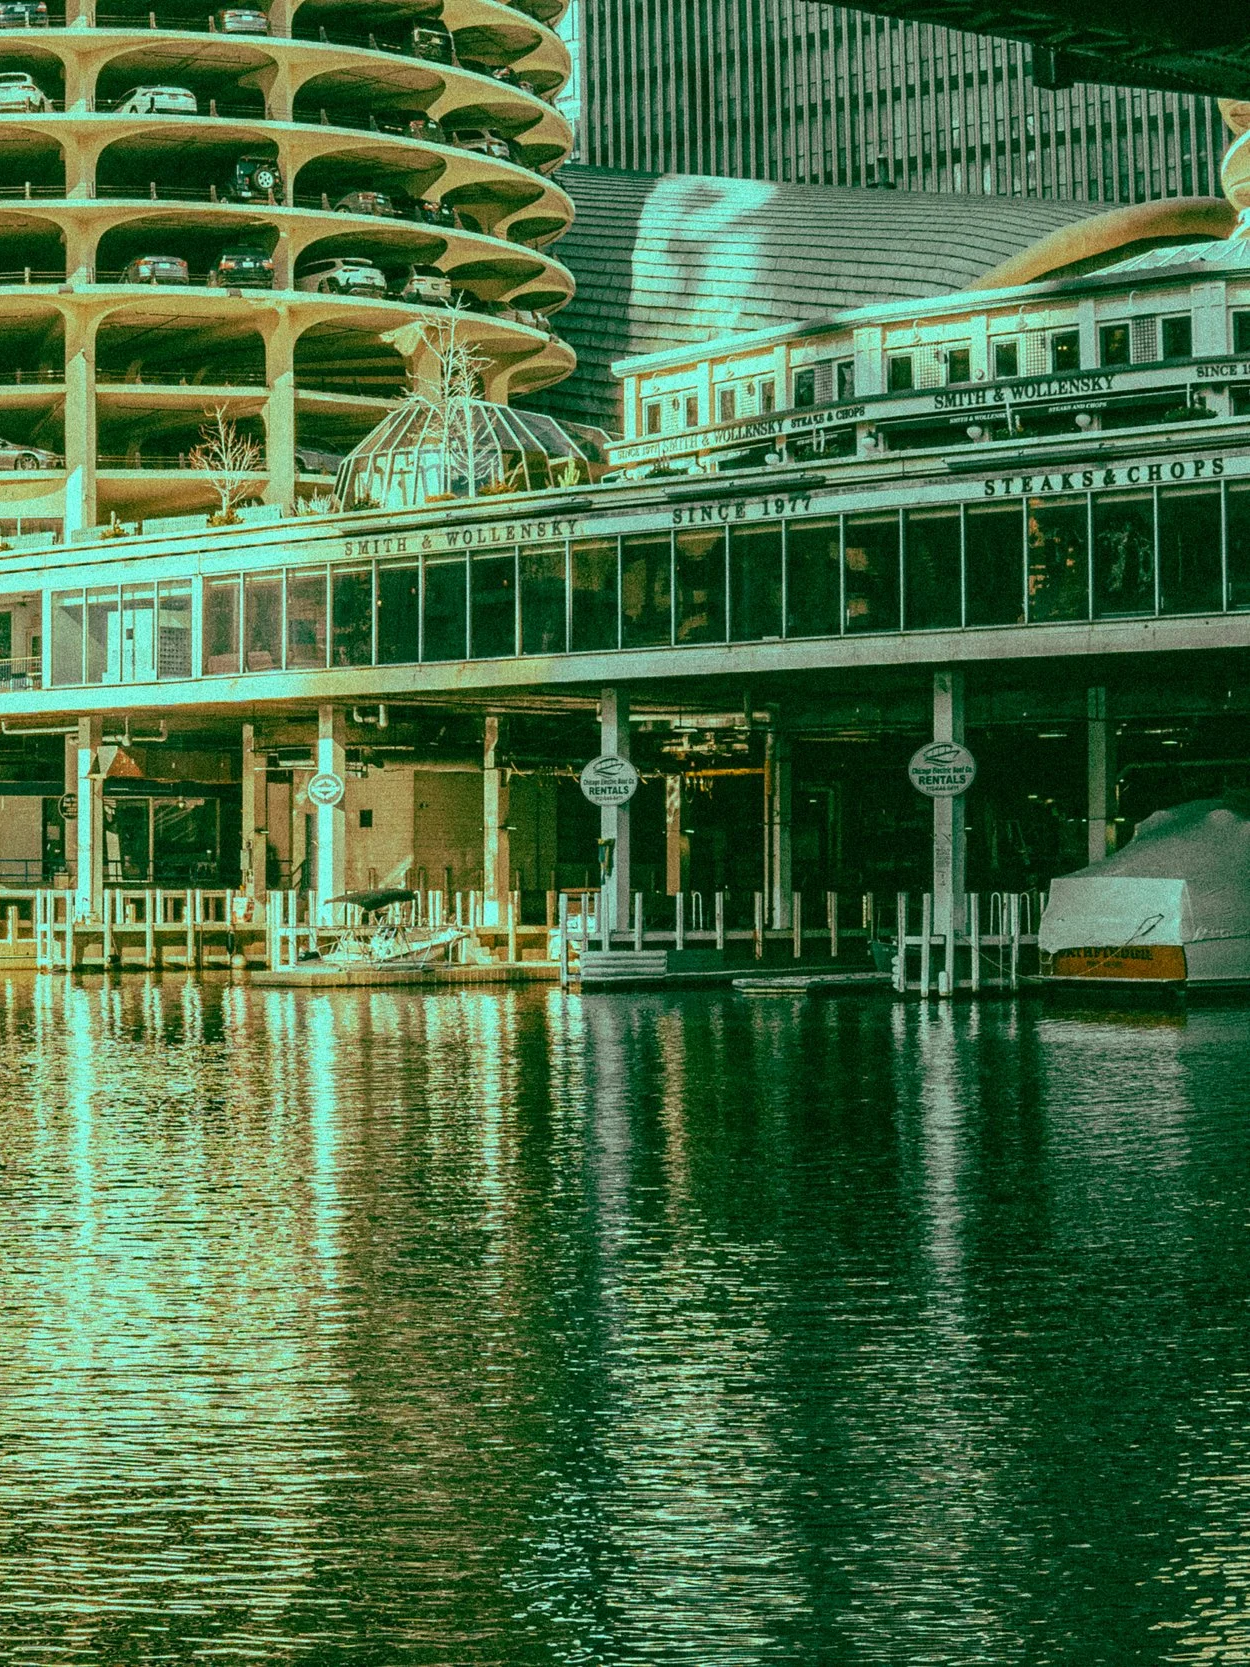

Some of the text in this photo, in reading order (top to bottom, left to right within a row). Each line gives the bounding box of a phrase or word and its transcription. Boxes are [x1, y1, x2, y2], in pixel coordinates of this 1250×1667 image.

[1196, 364, 1238, 378] SINCE
[934, 374, 1115, 410] SMITH & WOLLENSKY
[663, 434, 698, 452] SMITH
[701, 433, 710, 446] &
[714, 419, 785, 444] WOLLENSKY
[791, 413, 825, 428] STEAKS
[826, 410, 834, 422] &
[835, 406, 866, 420] CHOPS
[984, 457, 1225, 496] STEAKS & CHOPS
[672, 494, 812, 525] SINCE 1977
[345, 519, 578, 556] SMITH & WOLLENSKY
[588, 785, 630, 795] RENTALS
[918, 774, 966, 785] RENTALS
